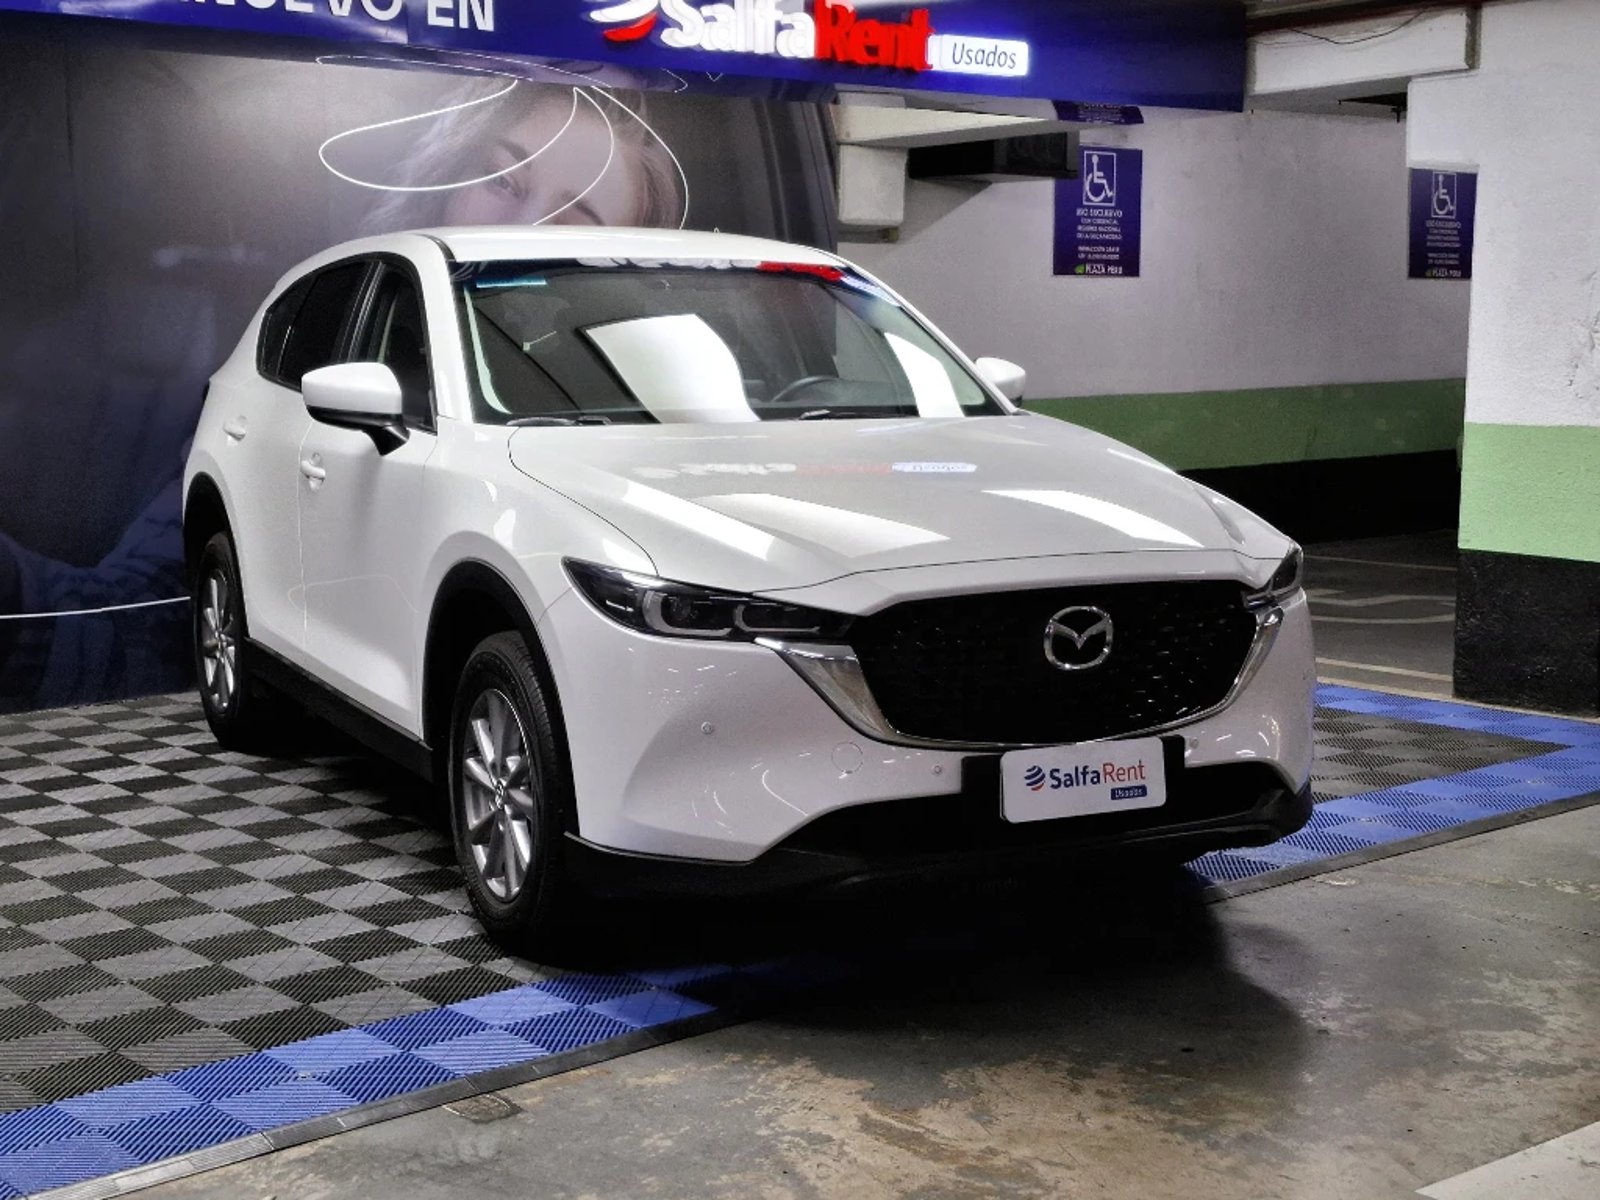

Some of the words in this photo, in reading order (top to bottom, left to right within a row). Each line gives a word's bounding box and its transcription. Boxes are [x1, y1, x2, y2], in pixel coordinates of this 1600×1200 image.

[427, 0, 494, 32] EN
[660, 0, 935, 71] SalfaRent
[952, 42, 1017, 69] Usados
[1049, 759, 1146, 789] SalfaRent
